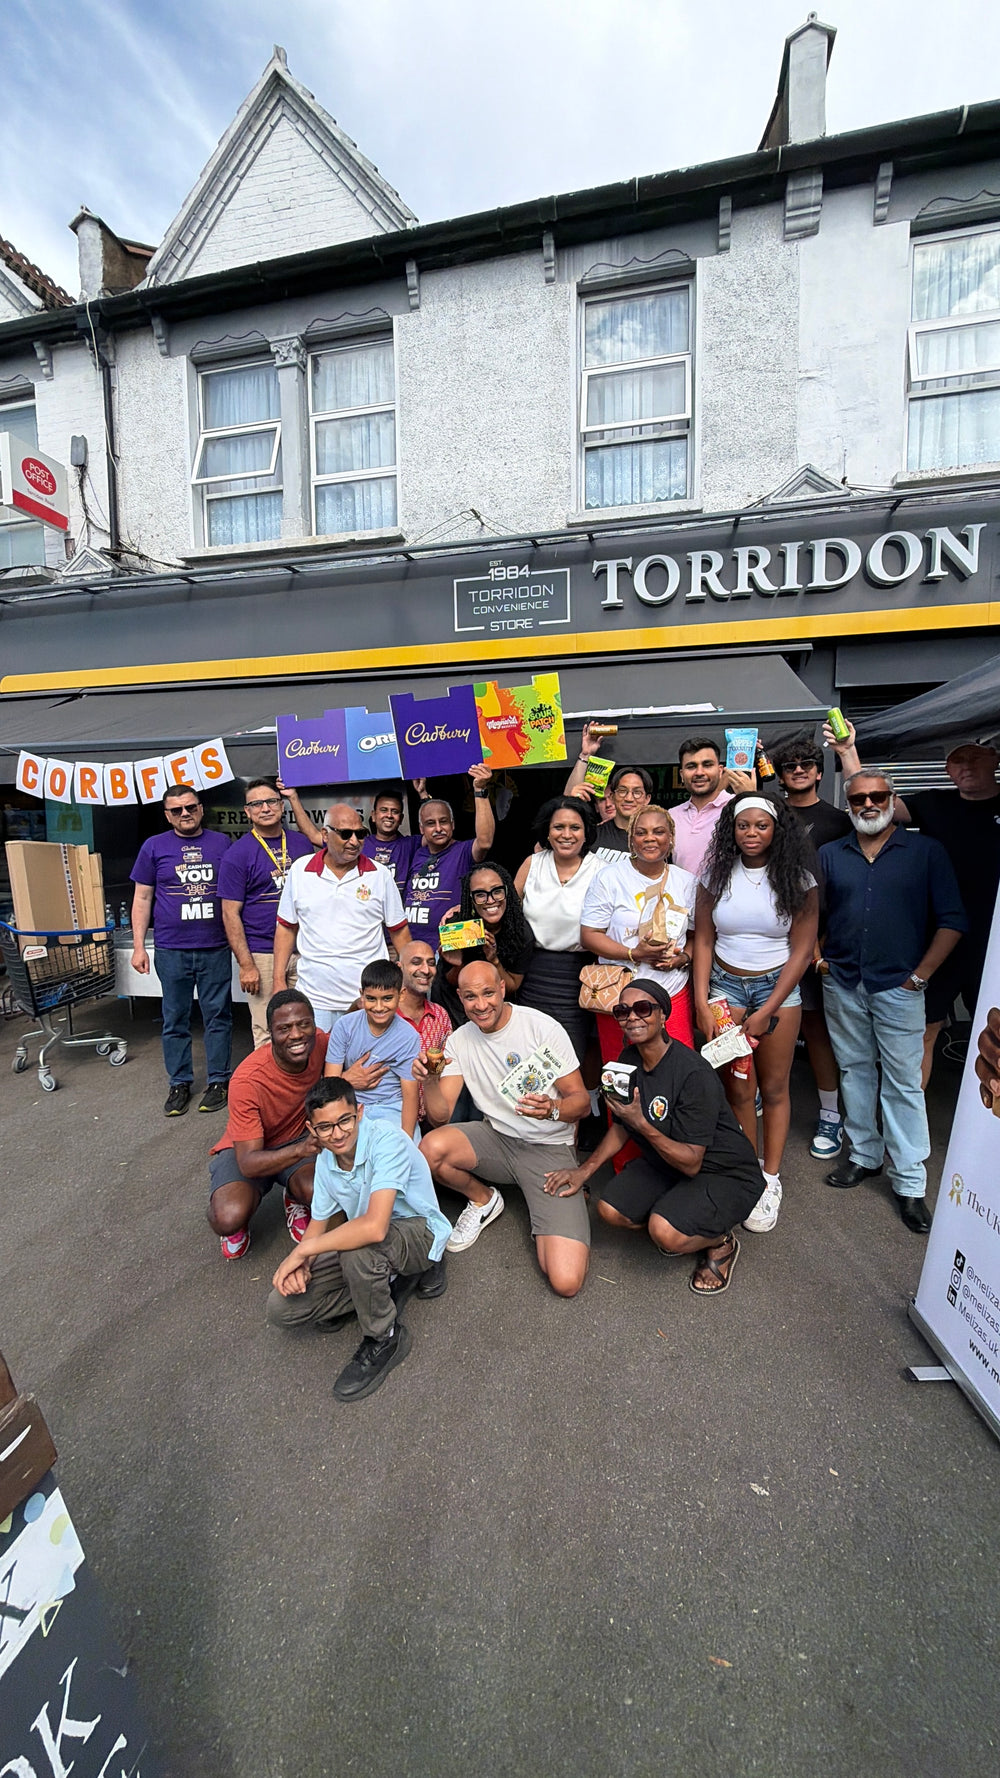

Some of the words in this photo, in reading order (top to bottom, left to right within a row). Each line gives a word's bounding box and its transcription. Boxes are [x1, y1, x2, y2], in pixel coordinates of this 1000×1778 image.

[29, 462, 50, 480] POST
[25, 469, 54, 493] OFFICE
[488, 564, 531, 581] 1984
[591, 523, 988, 610] TORRIDON
[468, 584, 555, 603] TORRIDON
[473, 600, 550, 615] CONVENIENCE
[490, 618, 534, 631] STORE
[529, 709, 553, 721] SOUR
[530, 716, 555, 729] PATCH
[405, 722, 471, 746] Cadbury
[285, 738, 341, 759] Cadbury
[22, 747, 224, 800] CORBFES
[217, 811, 253, 825] FRE
[175, 869, 214, 883] YOU
[412, 878, 440, 890] YOU
[181, 902, 214, 921] ME
[405, 906, 430, 924] ME
[967, 1189, 985, 1217] The
[958, 1301, 999, 1358] Melizas.uk
